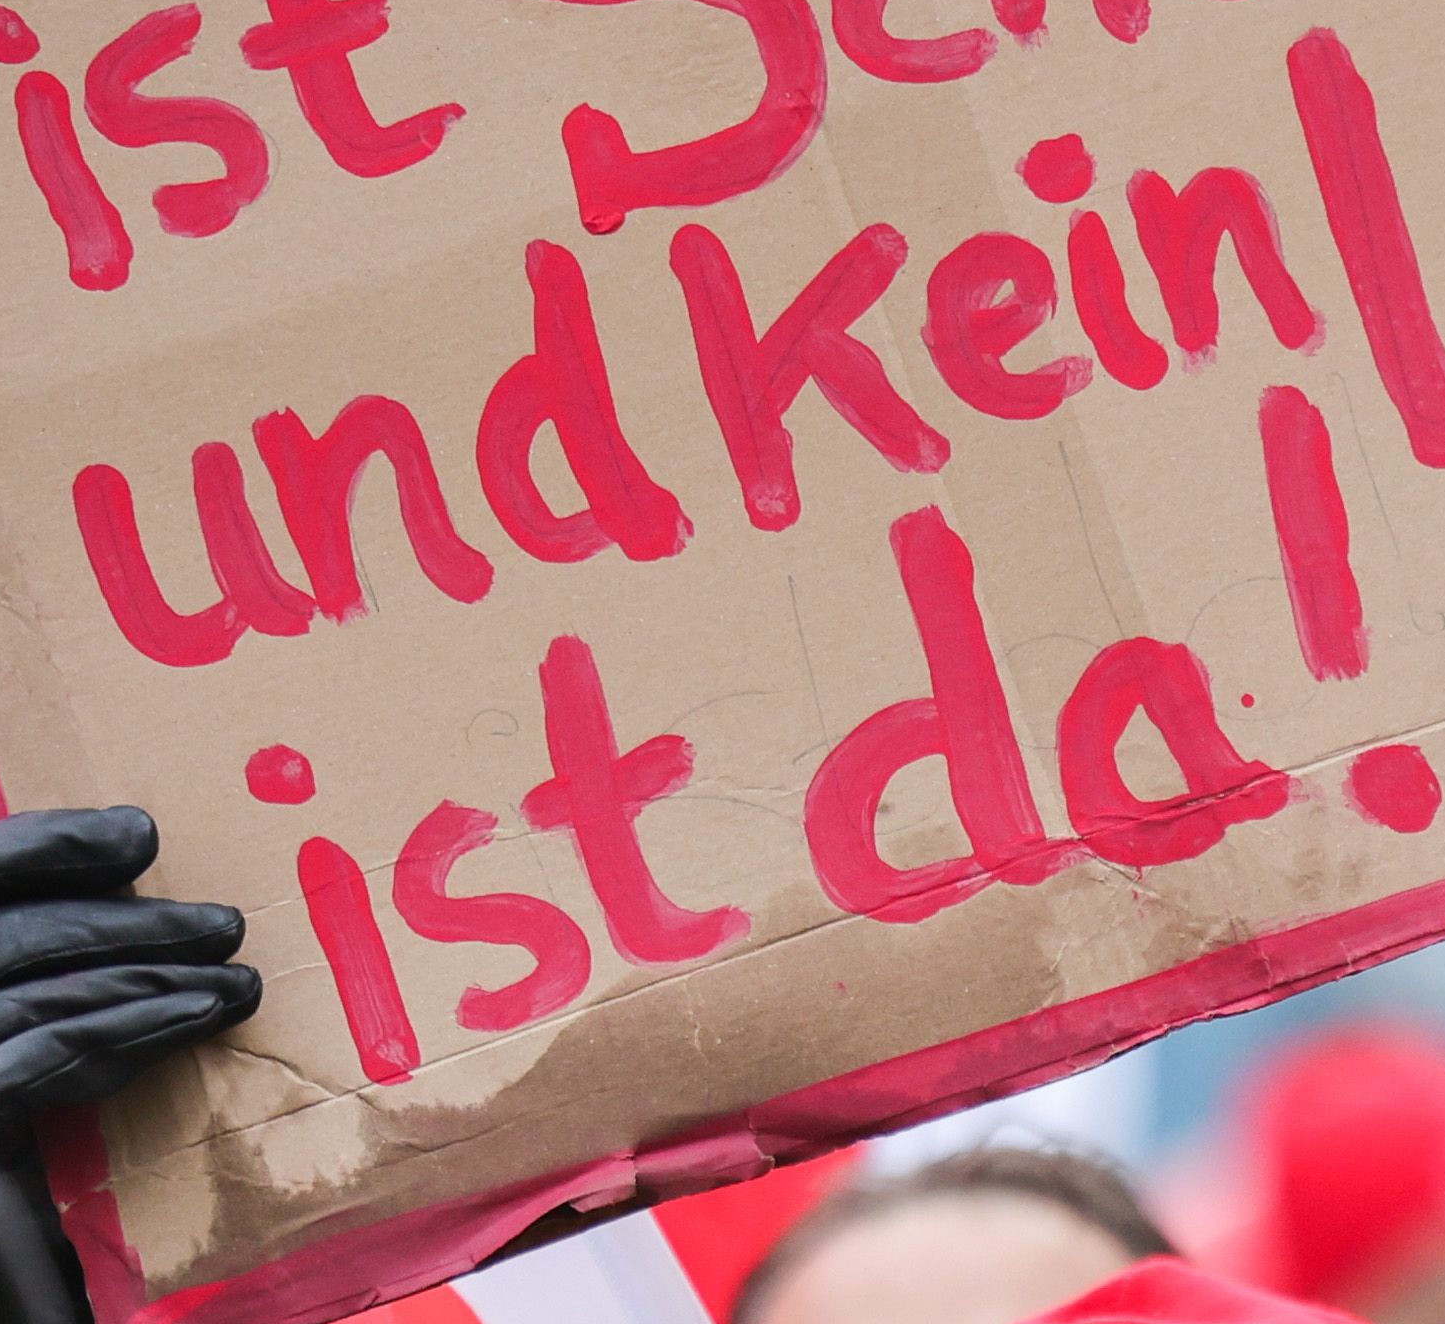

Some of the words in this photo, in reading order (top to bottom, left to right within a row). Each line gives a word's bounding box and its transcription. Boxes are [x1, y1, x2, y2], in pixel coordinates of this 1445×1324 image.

[73, 240, 693, 667] und
[246, 635, 744, 1085] ist
[805, 384, 1444, 926] da!
